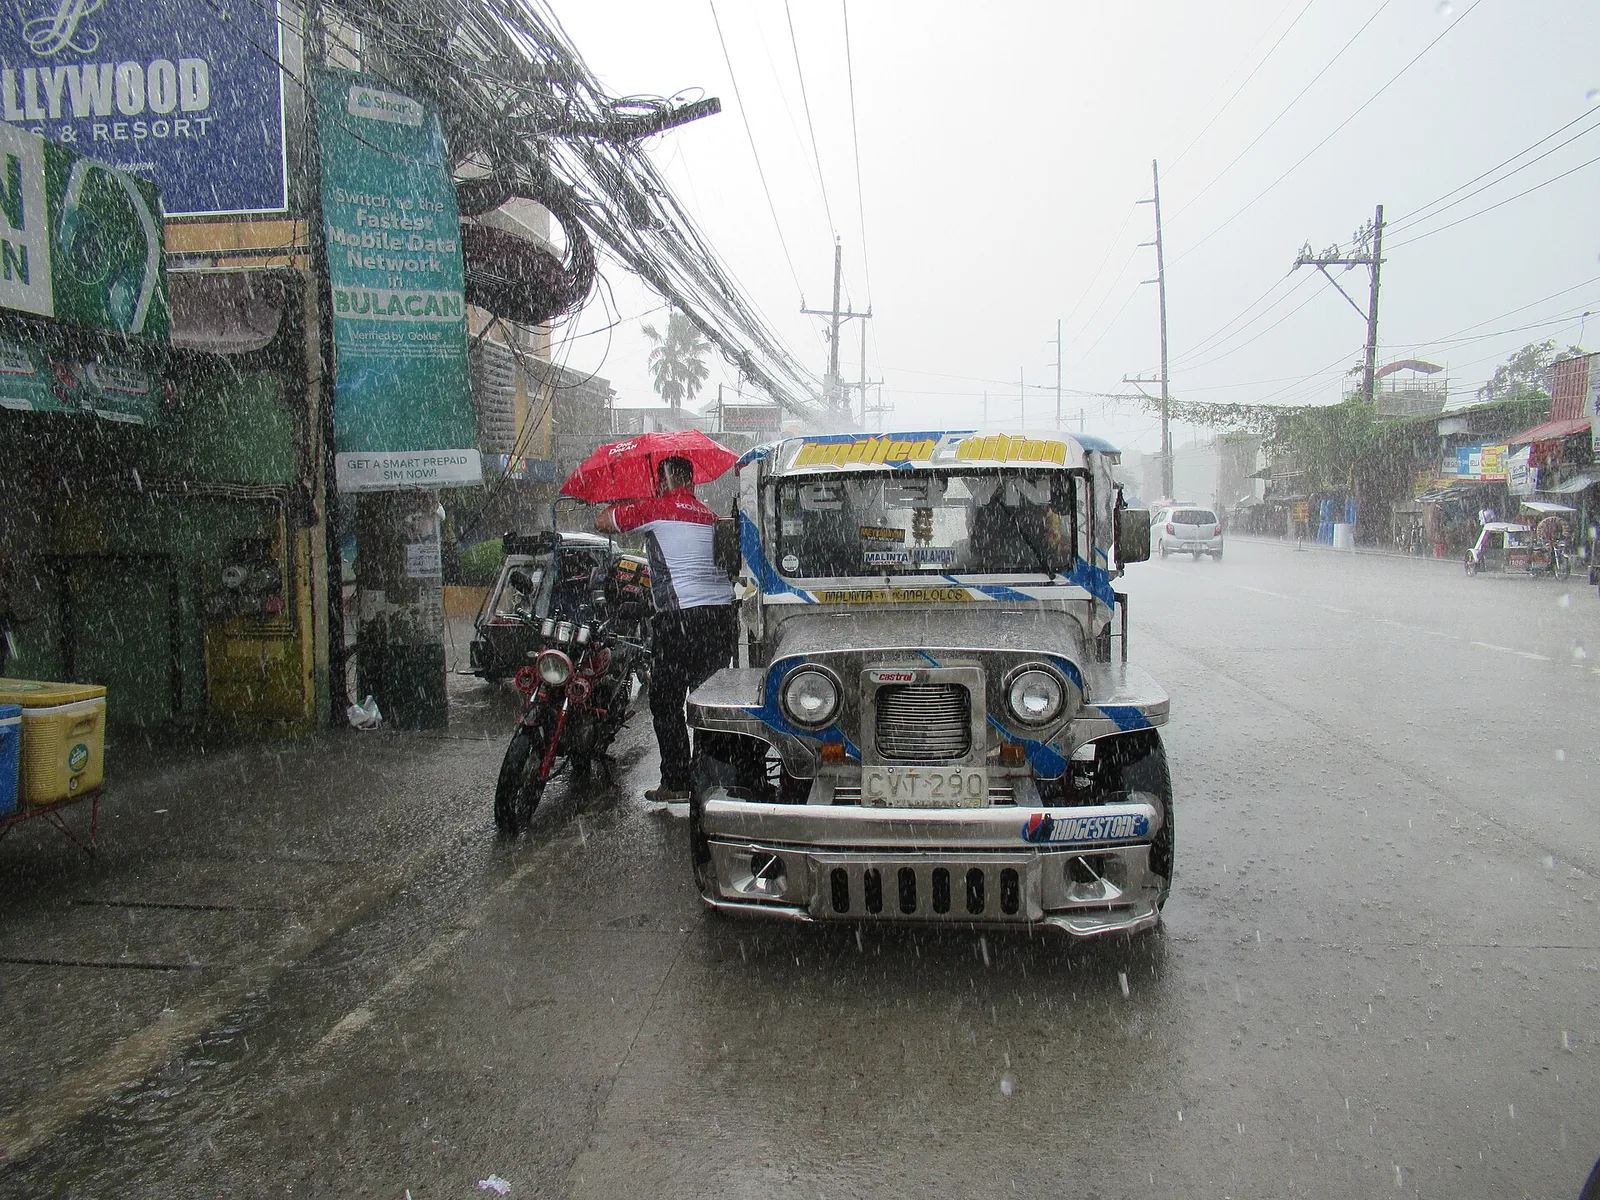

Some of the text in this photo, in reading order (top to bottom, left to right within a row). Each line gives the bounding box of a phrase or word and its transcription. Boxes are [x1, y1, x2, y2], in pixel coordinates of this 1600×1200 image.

[60, 125, 78, 142] &
[92, 117, 212, 141] RESORT
[335, 187, 444, 213] Switch to the
[356, 208, 434, 232] Fastest
[328, 226, 457, 253] Mobile Data
[347, 250, 441, 273] Network
[387, 274, 403, 289] in
[334, 289, 461, 317] BULACAN
[347, 456, 468, 470] GET A SMART PREPAID
[383, 468, 437, 481] SIM NOW!
[866, 553, 909, 562] MALINTA
[825, 591, 873, 602] MALINTA
[930, 773, 982, 798] 290
